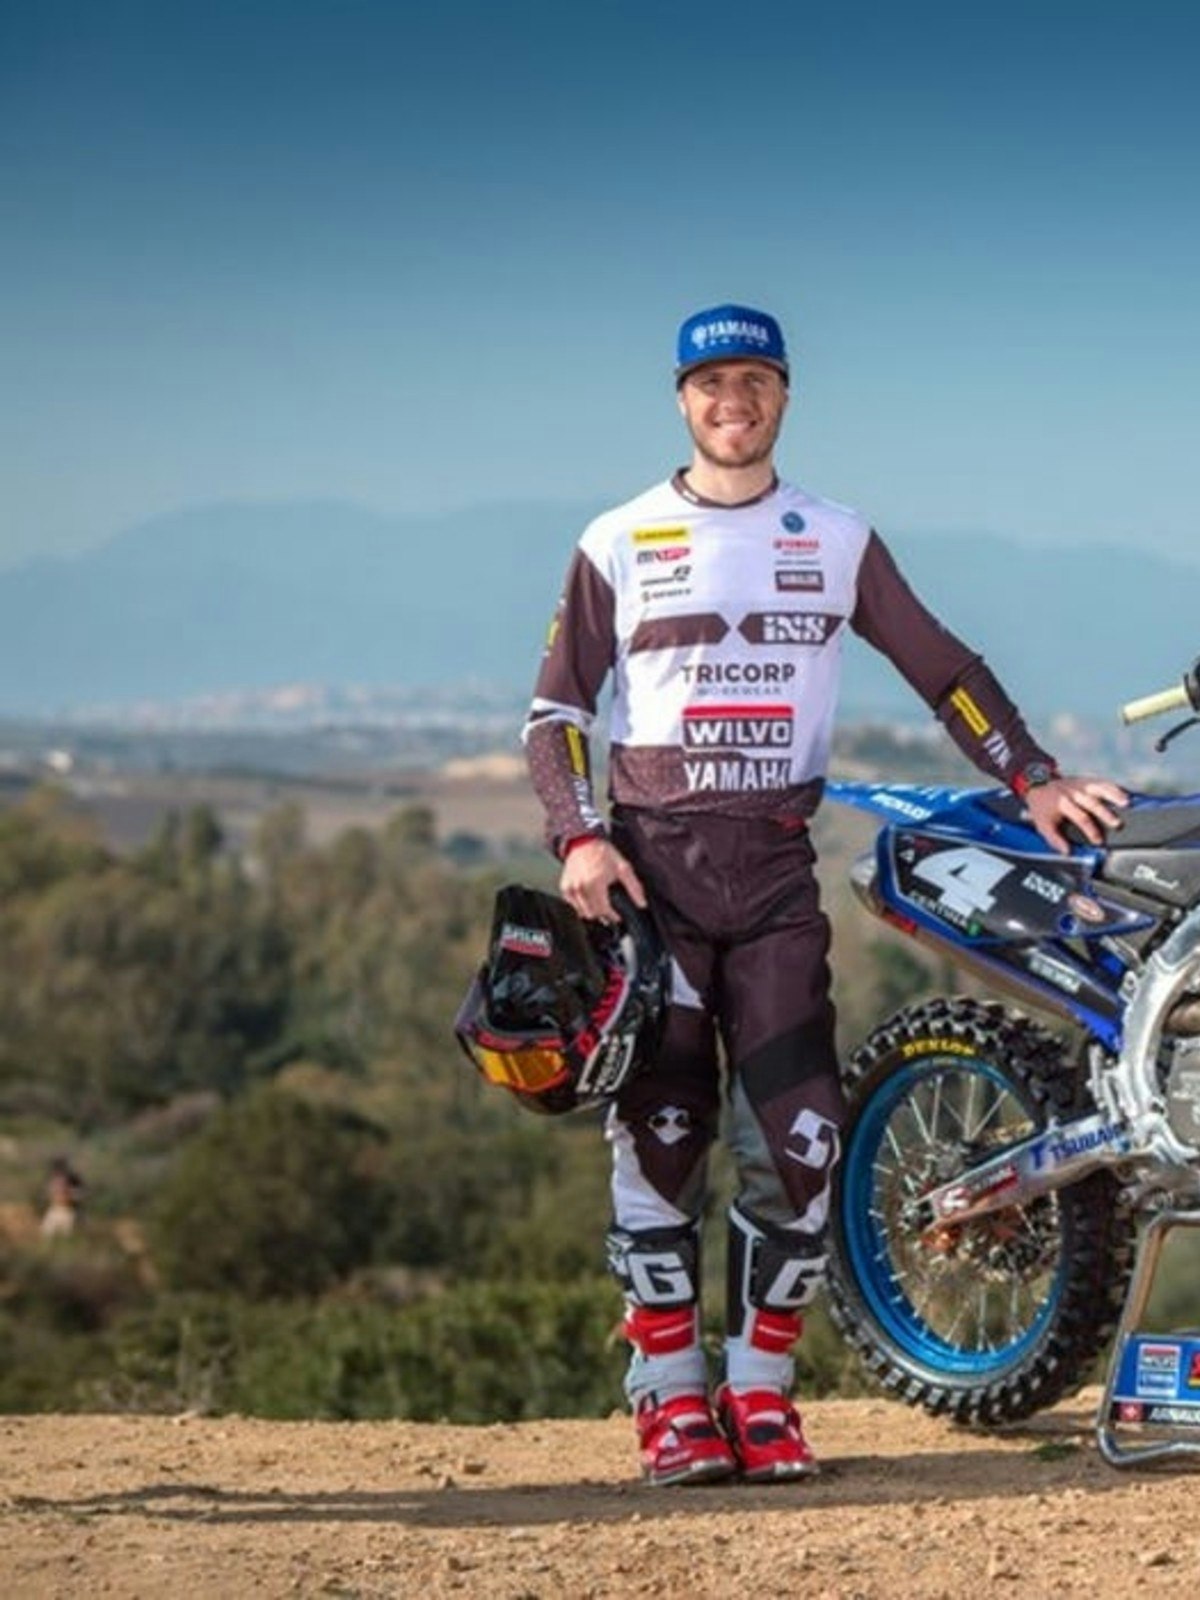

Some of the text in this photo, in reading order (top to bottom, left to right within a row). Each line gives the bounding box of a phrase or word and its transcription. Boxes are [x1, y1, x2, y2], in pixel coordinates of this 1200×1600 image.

[706, 320, 769, 343] YAMAHA
[681, 663, 796, 684] TRICORP
[687, 721, 790, 744] WILVO
[911, 847, 1016, 919] 4
